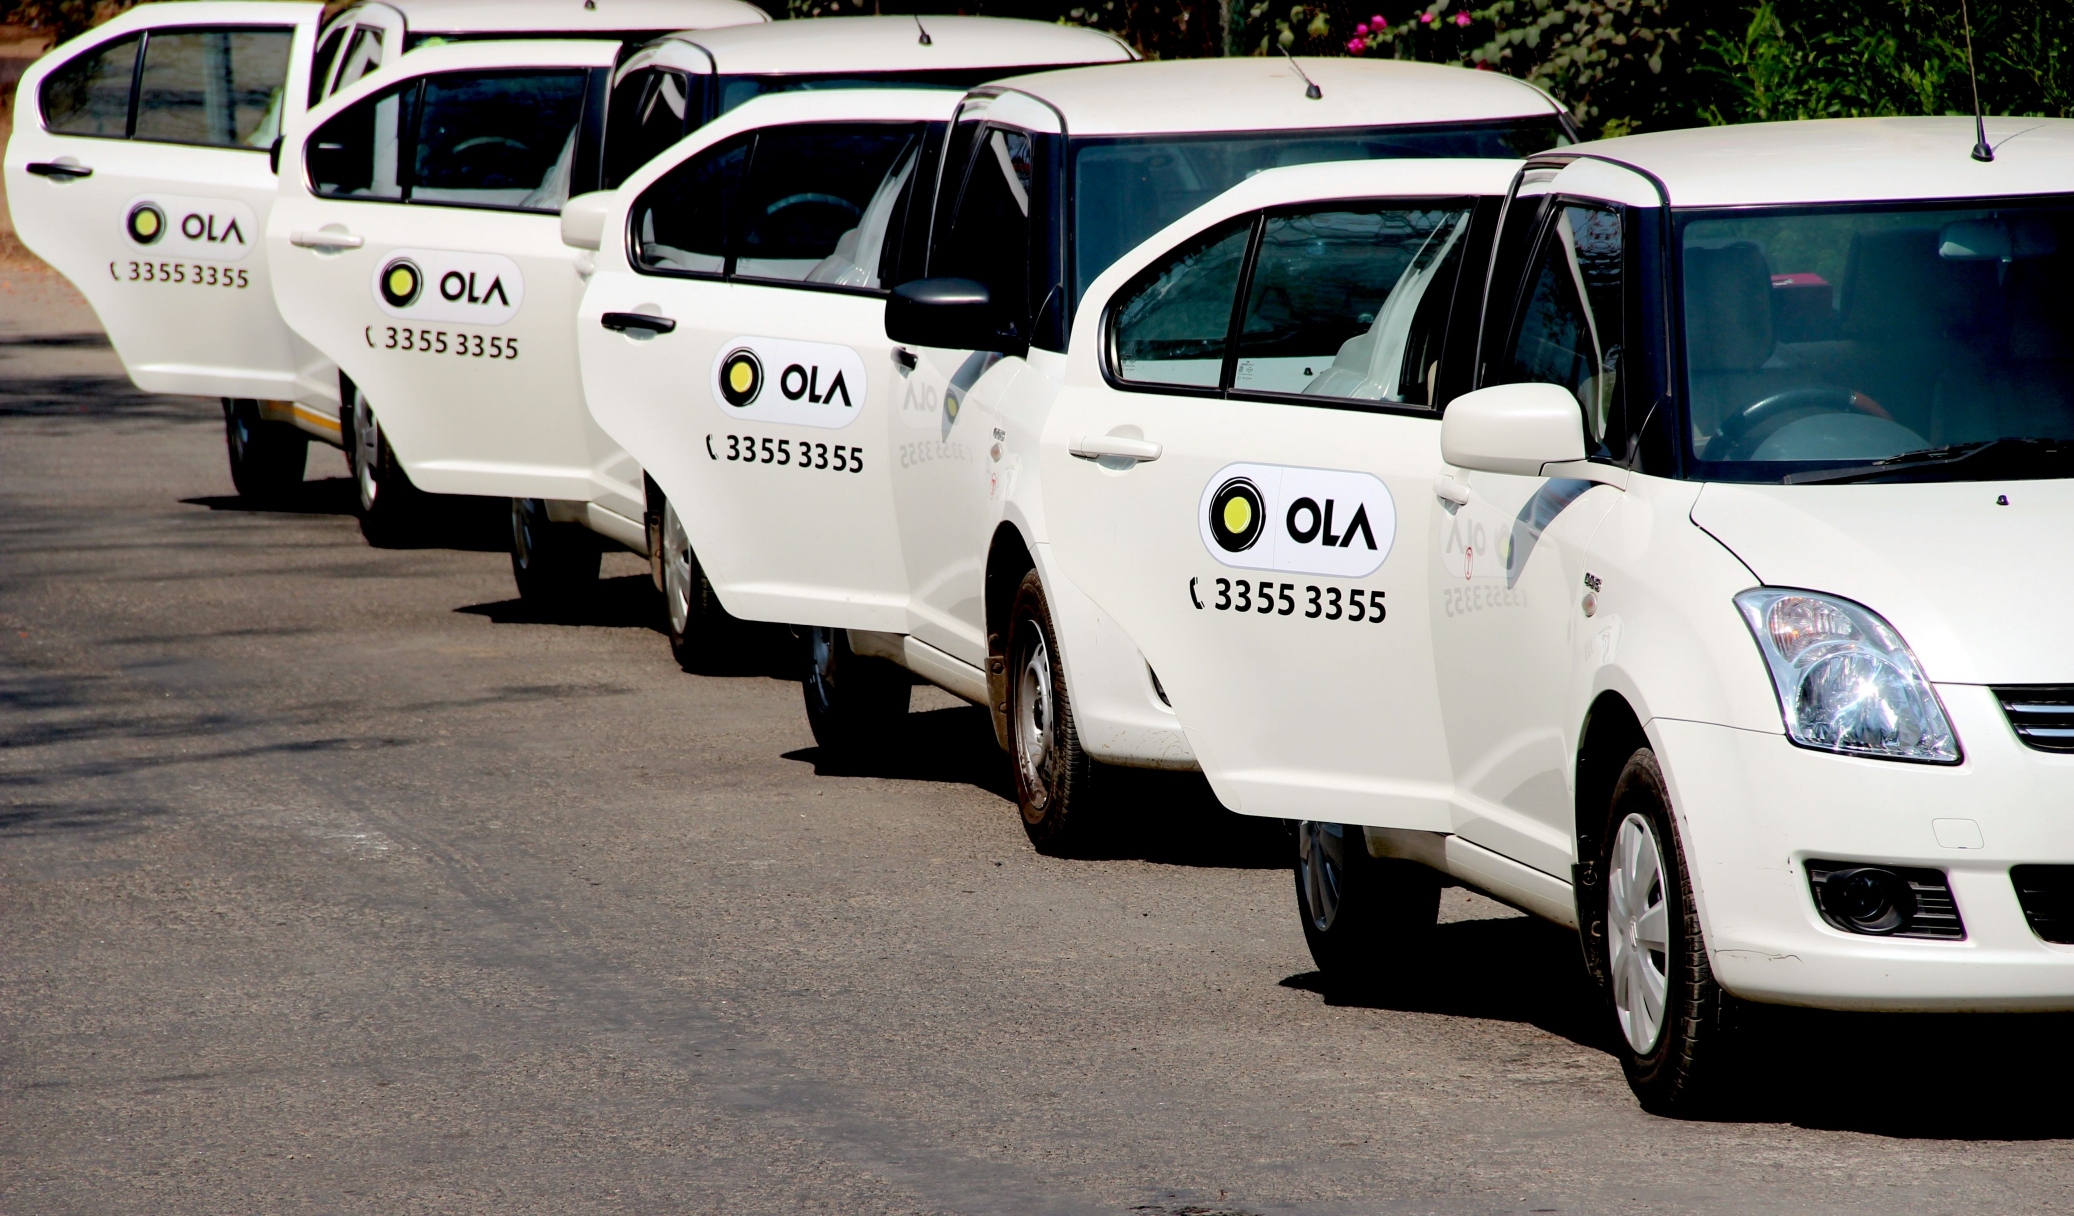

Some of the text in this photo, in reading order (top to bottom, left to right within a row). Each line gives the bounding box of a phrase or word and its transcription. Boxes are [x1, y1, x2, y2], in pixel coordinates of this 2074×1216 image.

[182, 213, 245, 245] OLA
[129, 261, 249, 289] 3355 3355
[439, 270, 510, 307] OLA
[385, 326, 519, 360] 3355 3355
[780, 363, 853, 408] OLA
[726, 434, 864, 474] 3355 3355
[1285, 496, 1378, 551] OLA
[1214, 577, 1387, 624] 3355 3355
